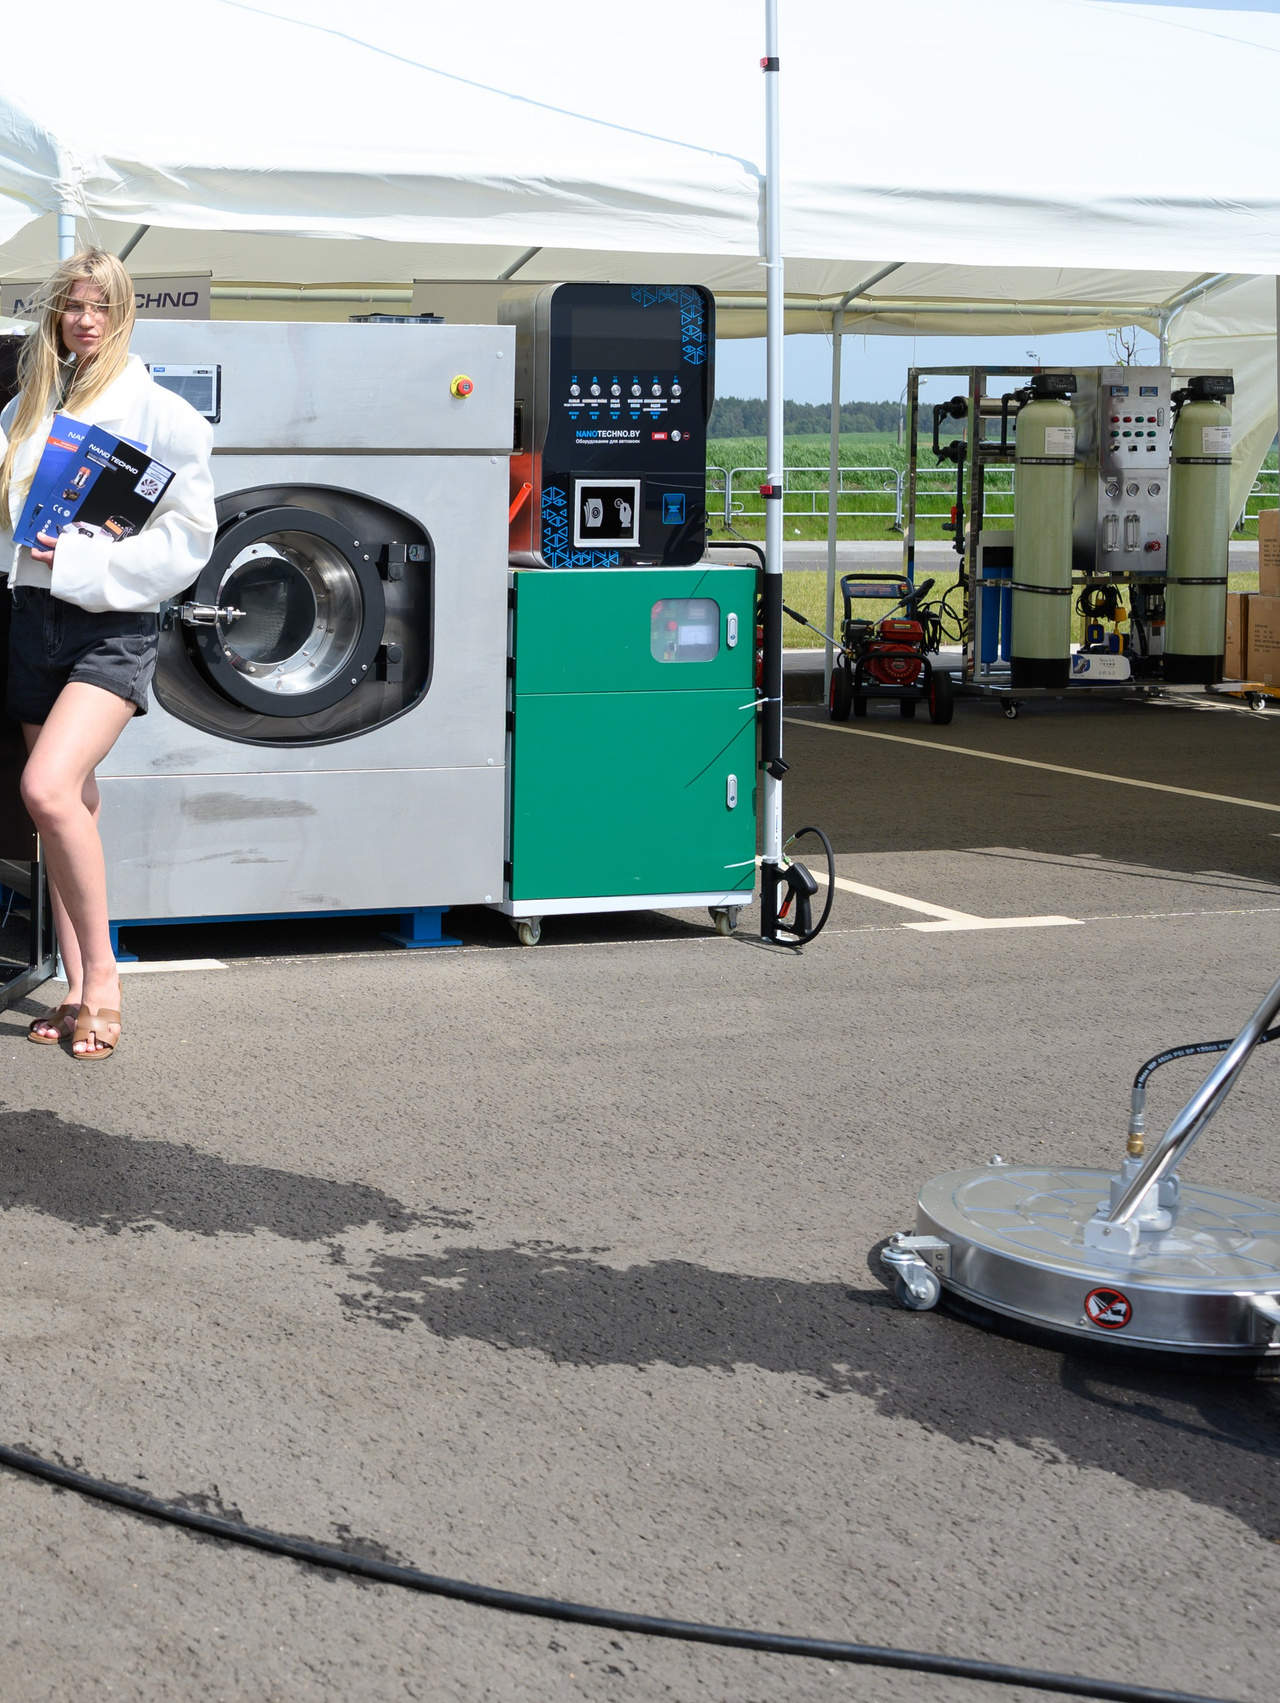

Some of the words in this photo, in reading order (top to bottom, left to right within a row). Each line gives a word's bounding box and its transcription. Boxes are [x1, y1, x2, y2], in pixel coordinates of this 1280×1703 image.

[134, 291, 199, 309] CHNO
[68, 431, 85, 440] NAN
[576, 430, 640, 438] NANOTECHNO.BY
[88, 443, 111, 459] NANO
[110, 455, 139, 475] TECHNO
[1147, 1061, 1158, 1071] WP
[1173, 1050, 1184, 1058] PSI
[1196, 1045, 1218, 1053] 12000
